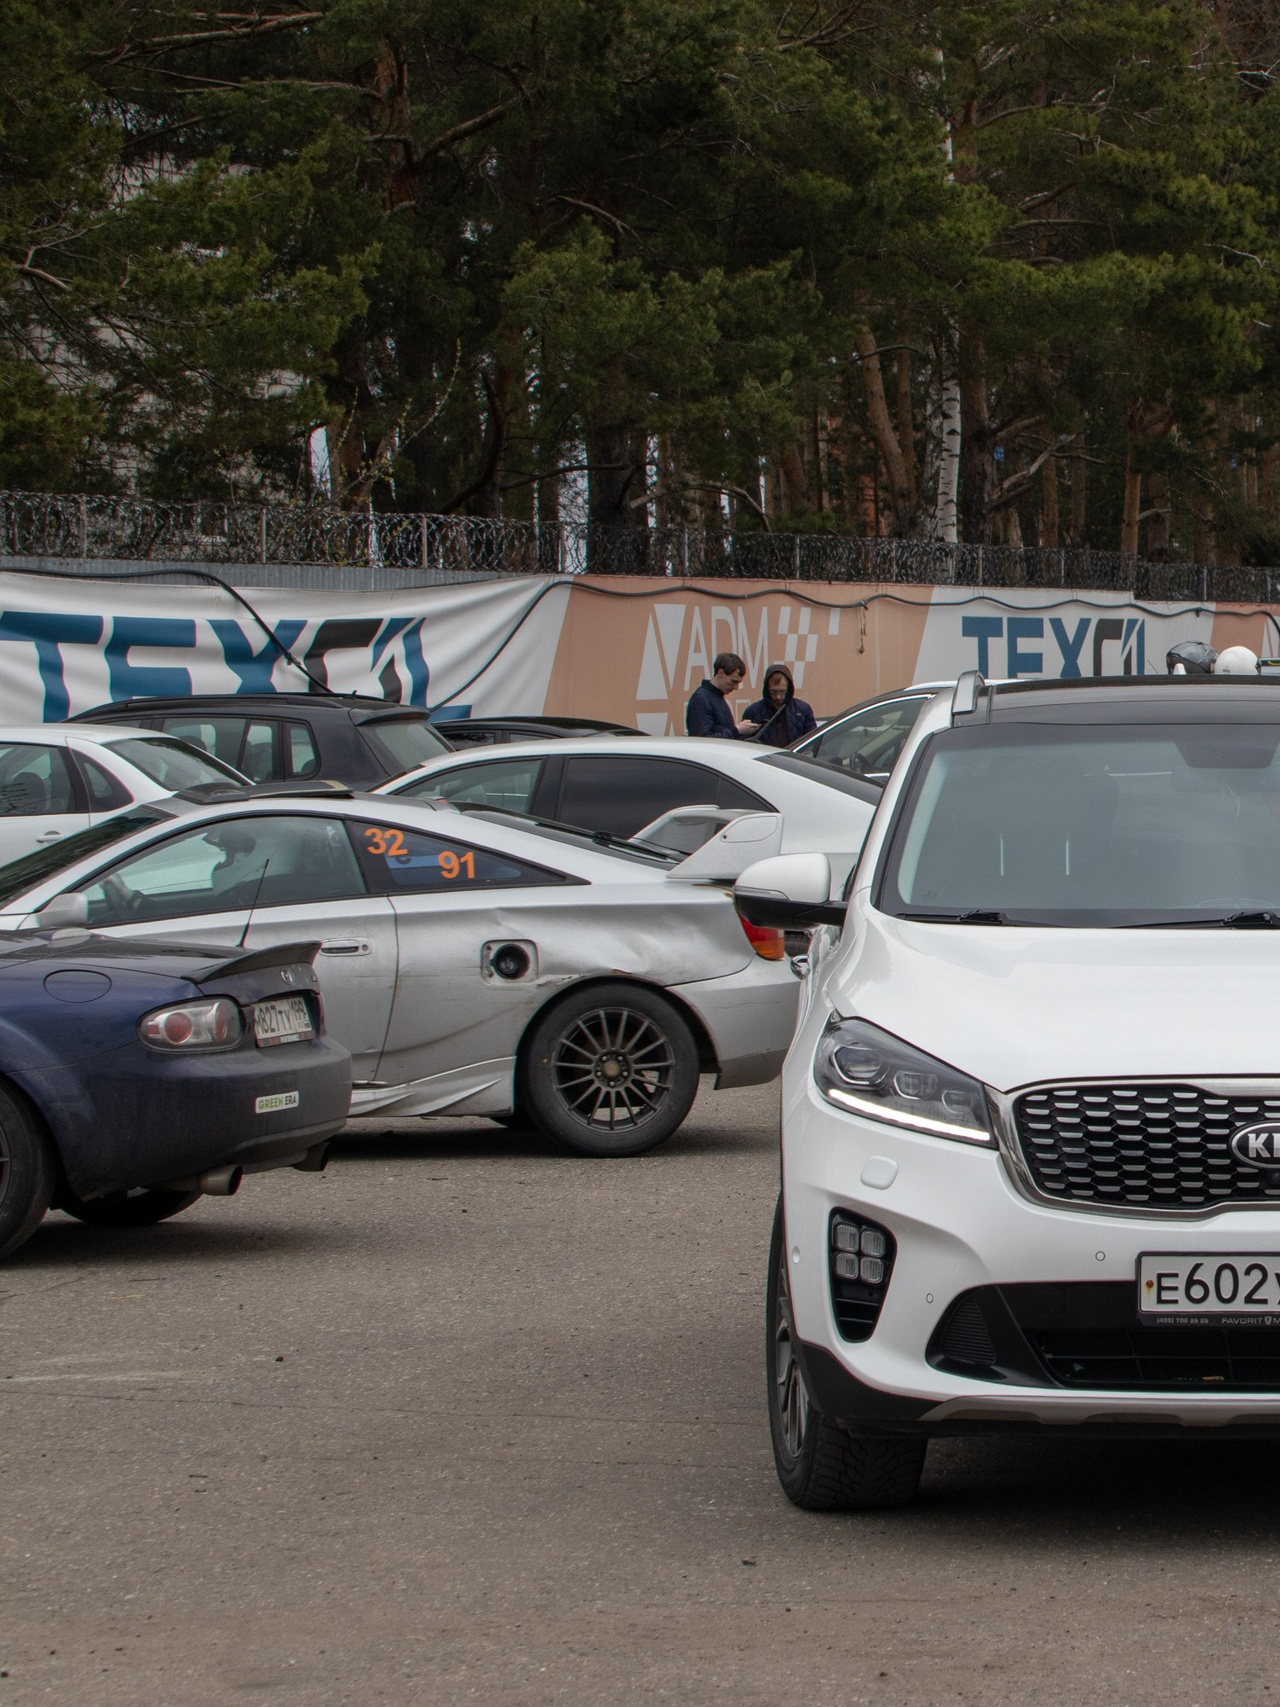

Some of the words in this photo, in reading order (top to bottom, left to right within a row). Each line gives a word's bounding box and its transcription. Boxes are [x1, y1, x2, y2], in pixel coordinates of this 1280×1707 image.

[364, 827, 409, 857] 32
[438, 850, 476, 879] 91
[258, 1096, 284, 1110] GREEN
